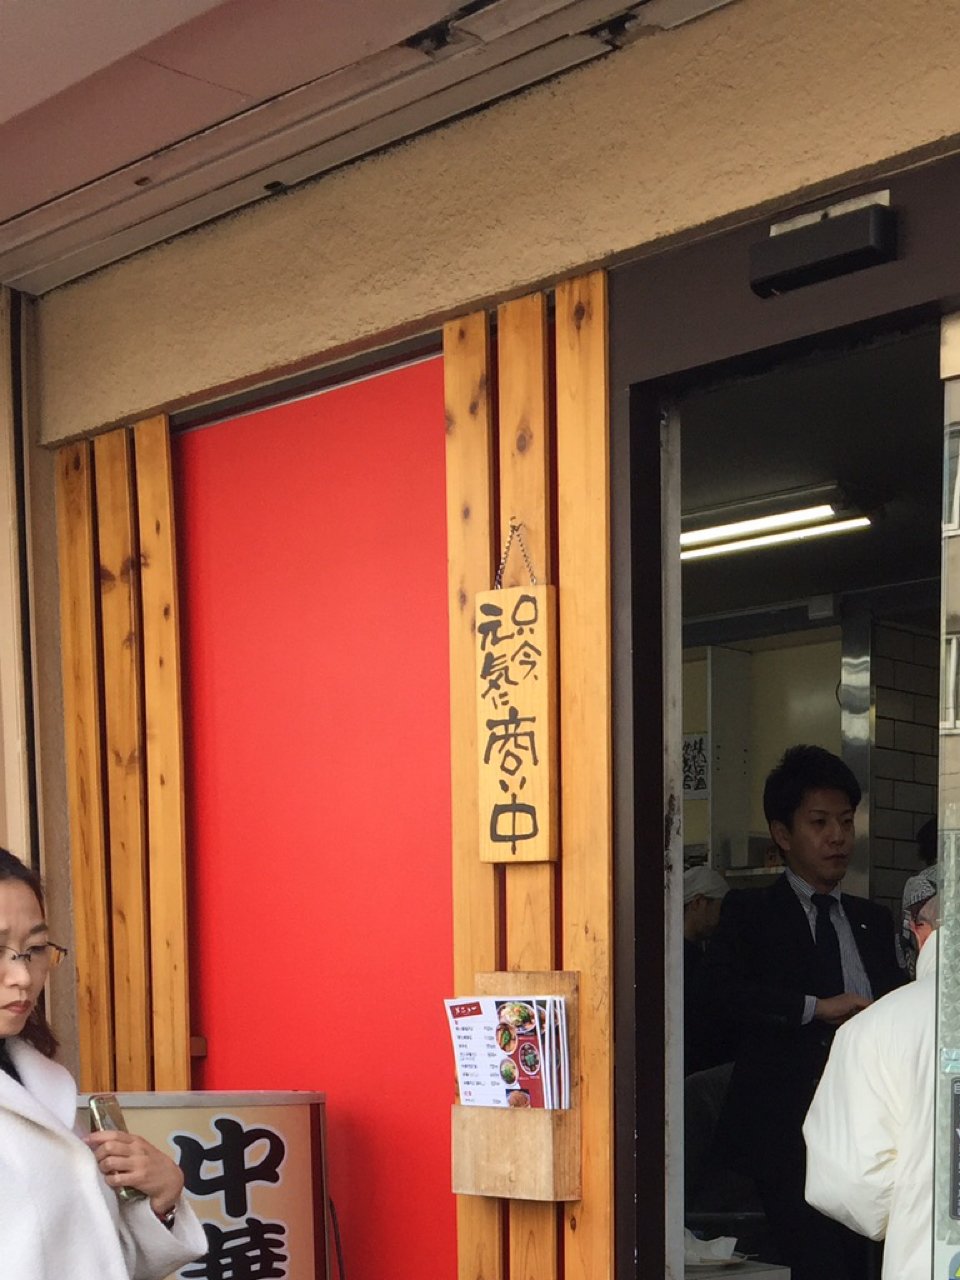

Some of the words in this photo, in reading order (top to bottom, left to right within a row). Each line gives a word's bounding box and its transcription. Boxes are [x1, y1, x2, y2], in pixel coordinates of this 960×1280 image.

[477, 602, 519, 710] 元気に
[510, 594, 542, 681] 只今
[483, 705, 539, 855] 商い中
